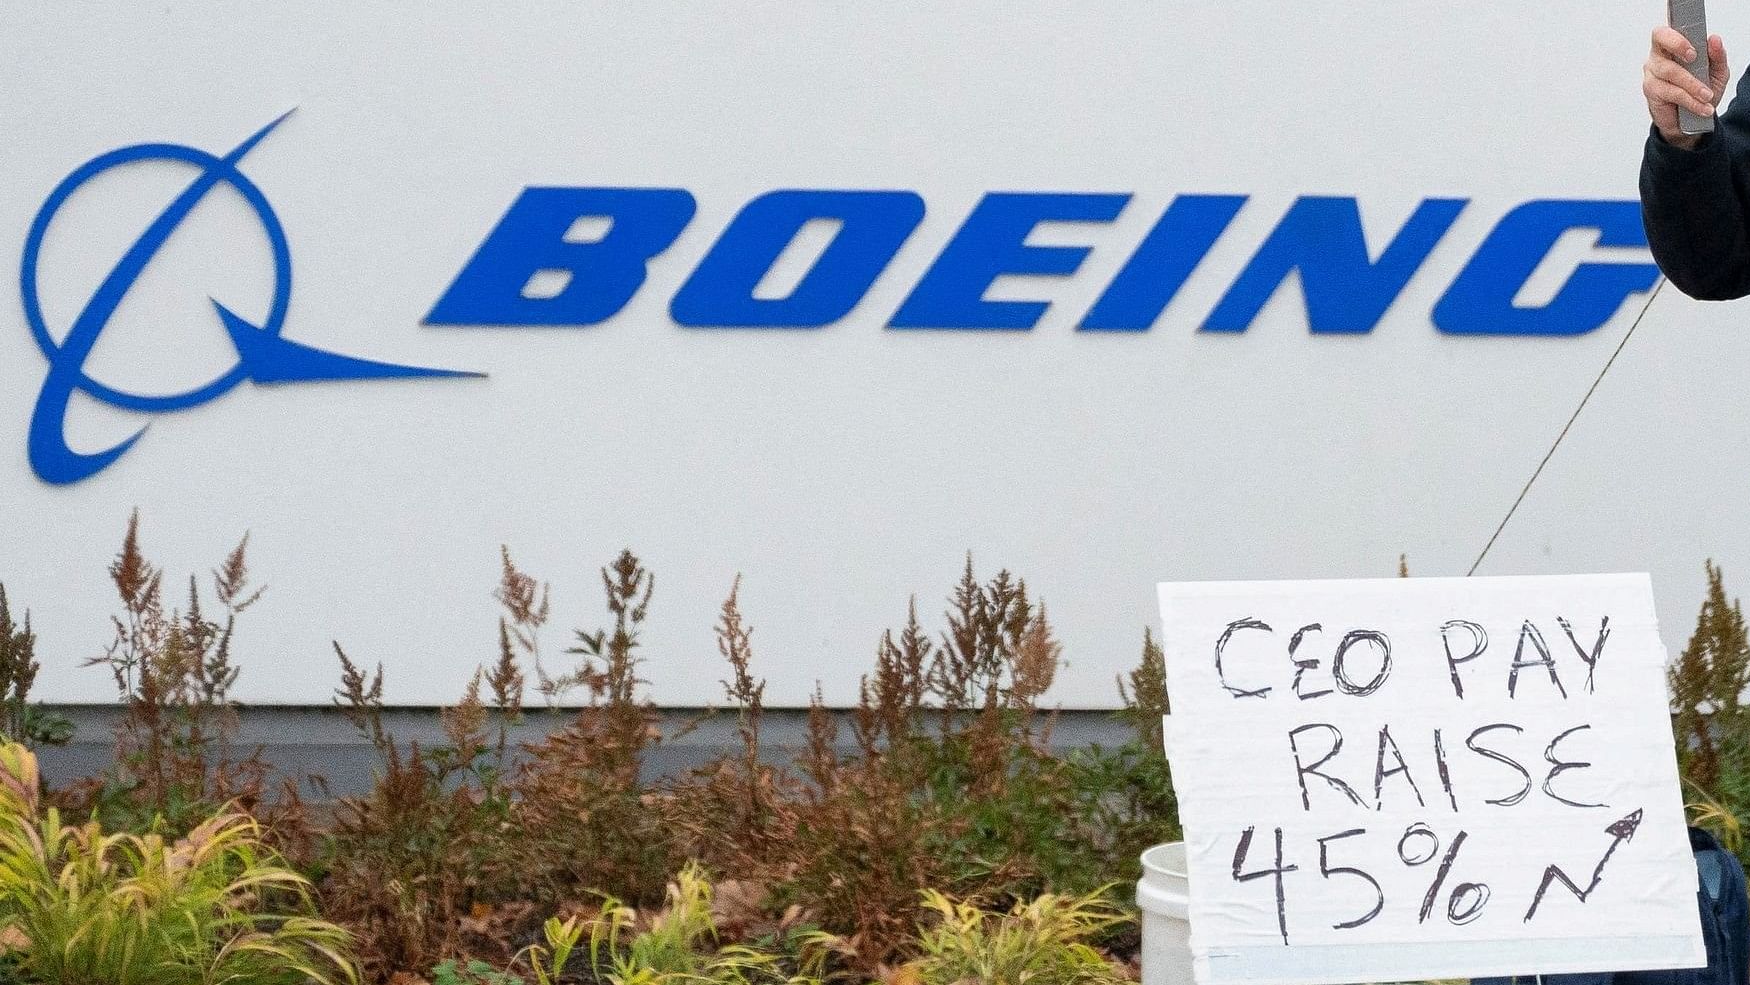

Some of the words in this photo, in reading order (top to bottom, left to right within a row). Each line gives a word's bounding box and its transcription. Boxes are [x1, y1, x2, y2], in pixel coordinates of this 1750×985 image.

[421, 184, 1664, 338] BOEING
[1214, 616, 1393, 700] CEO
[1439, 615, 1610, 701] PAY
[1287, 723, 1611, 813] RAISE
[1231, 821, 1492, 947] 45%
